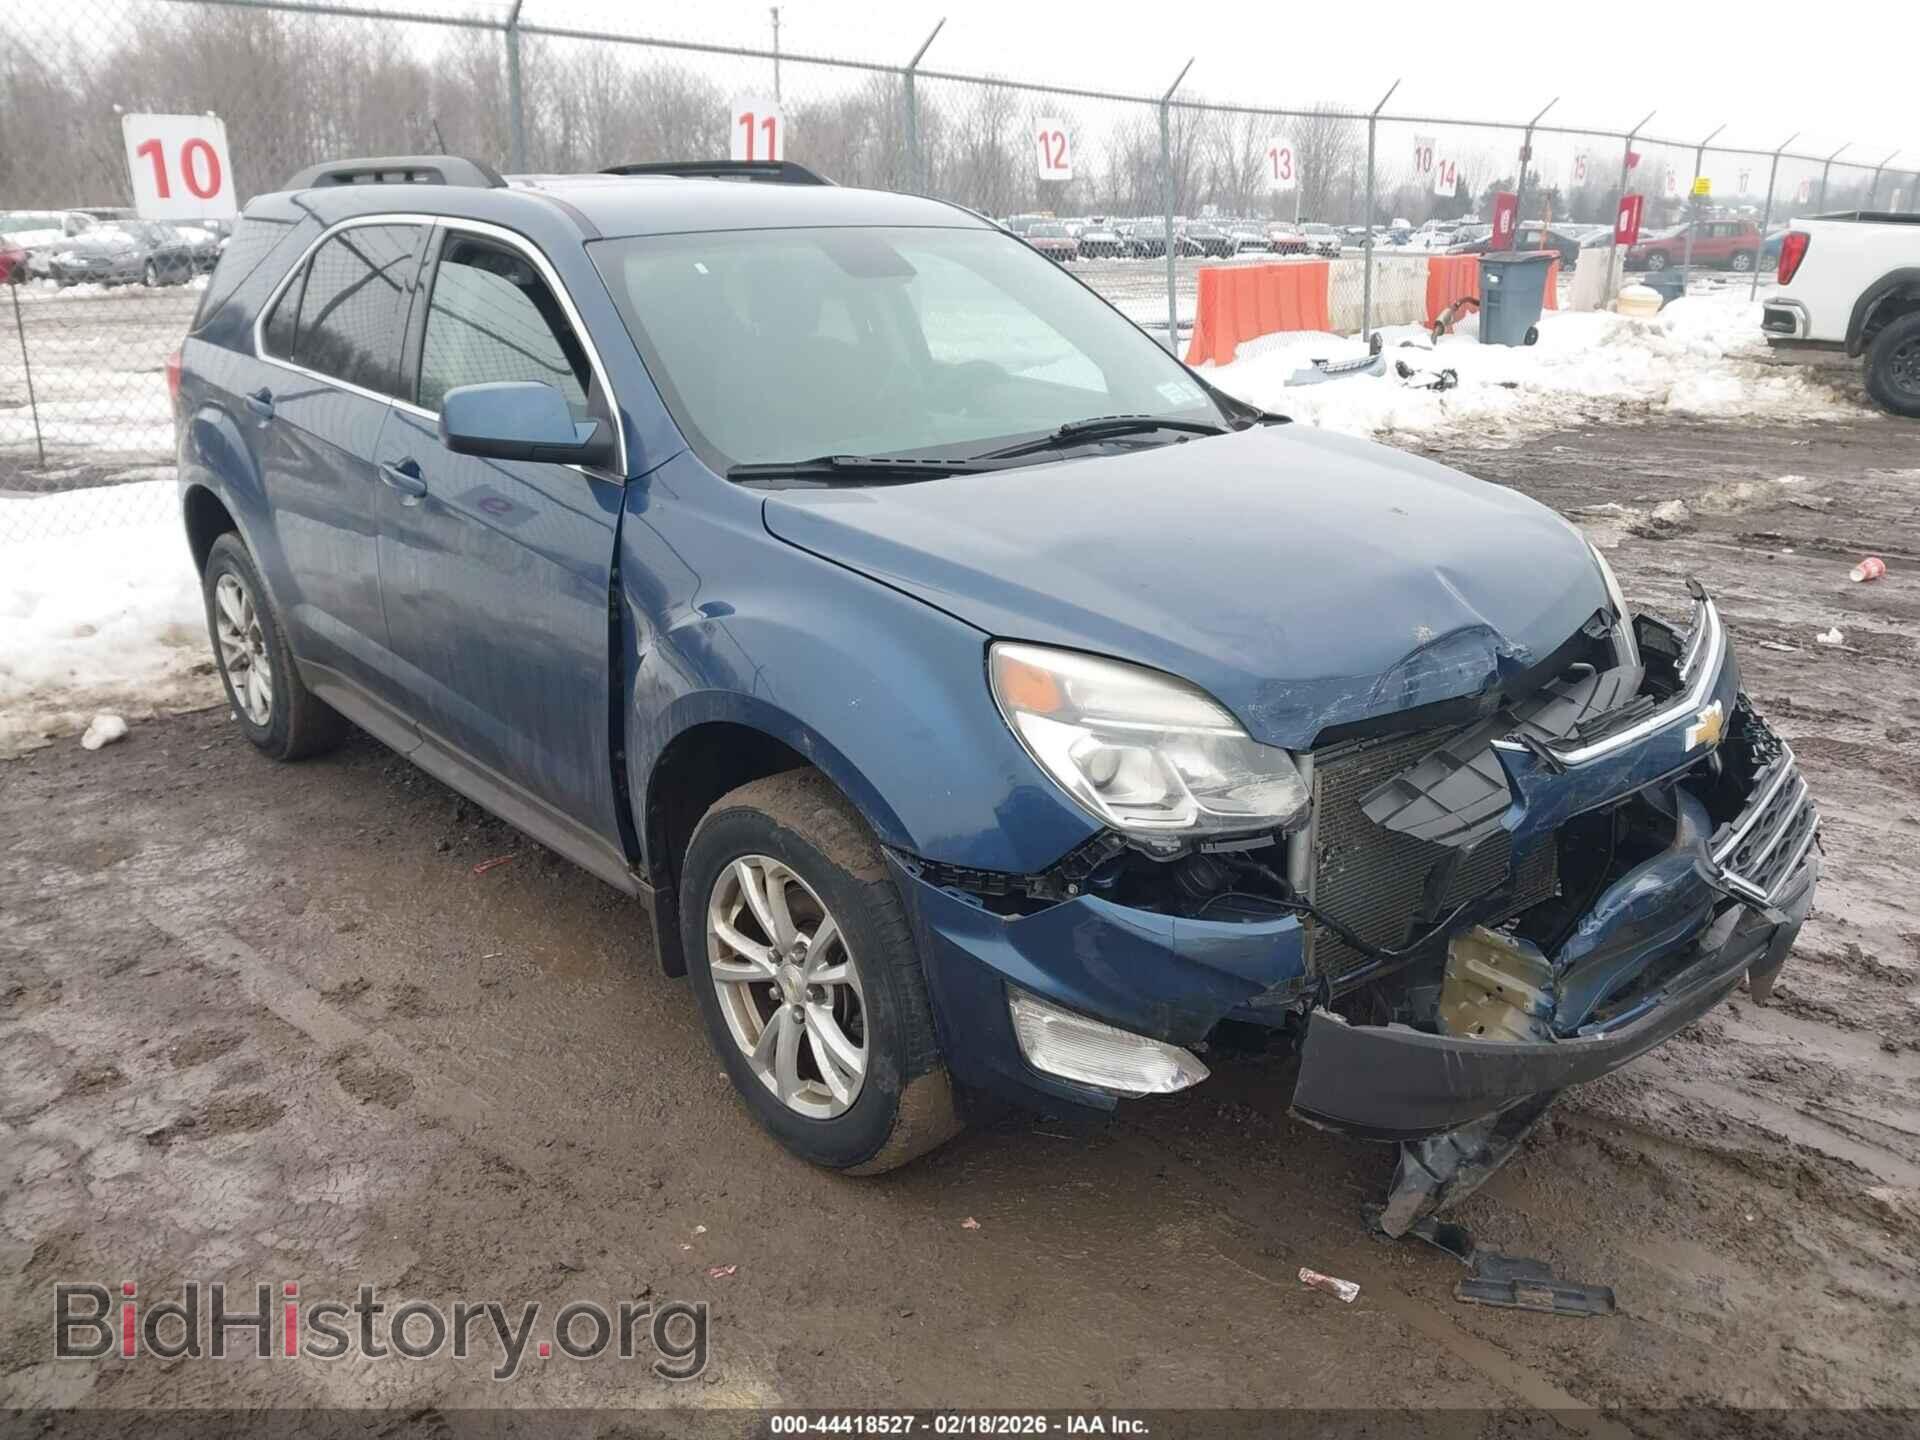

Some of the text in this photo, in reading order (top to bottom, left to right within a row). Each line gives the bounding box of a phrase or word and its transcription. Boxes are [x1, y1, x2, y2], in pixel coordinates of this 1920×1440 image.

[738, 111, 777, 161] 11
[1038, 130, 1069, 170] 12
[136, 137, 223, 200] 10
[1268, 147, 1293, 181] 13
[1415, 147, 1433, 173] 10
[1439, 159, 1457, 190] 14
